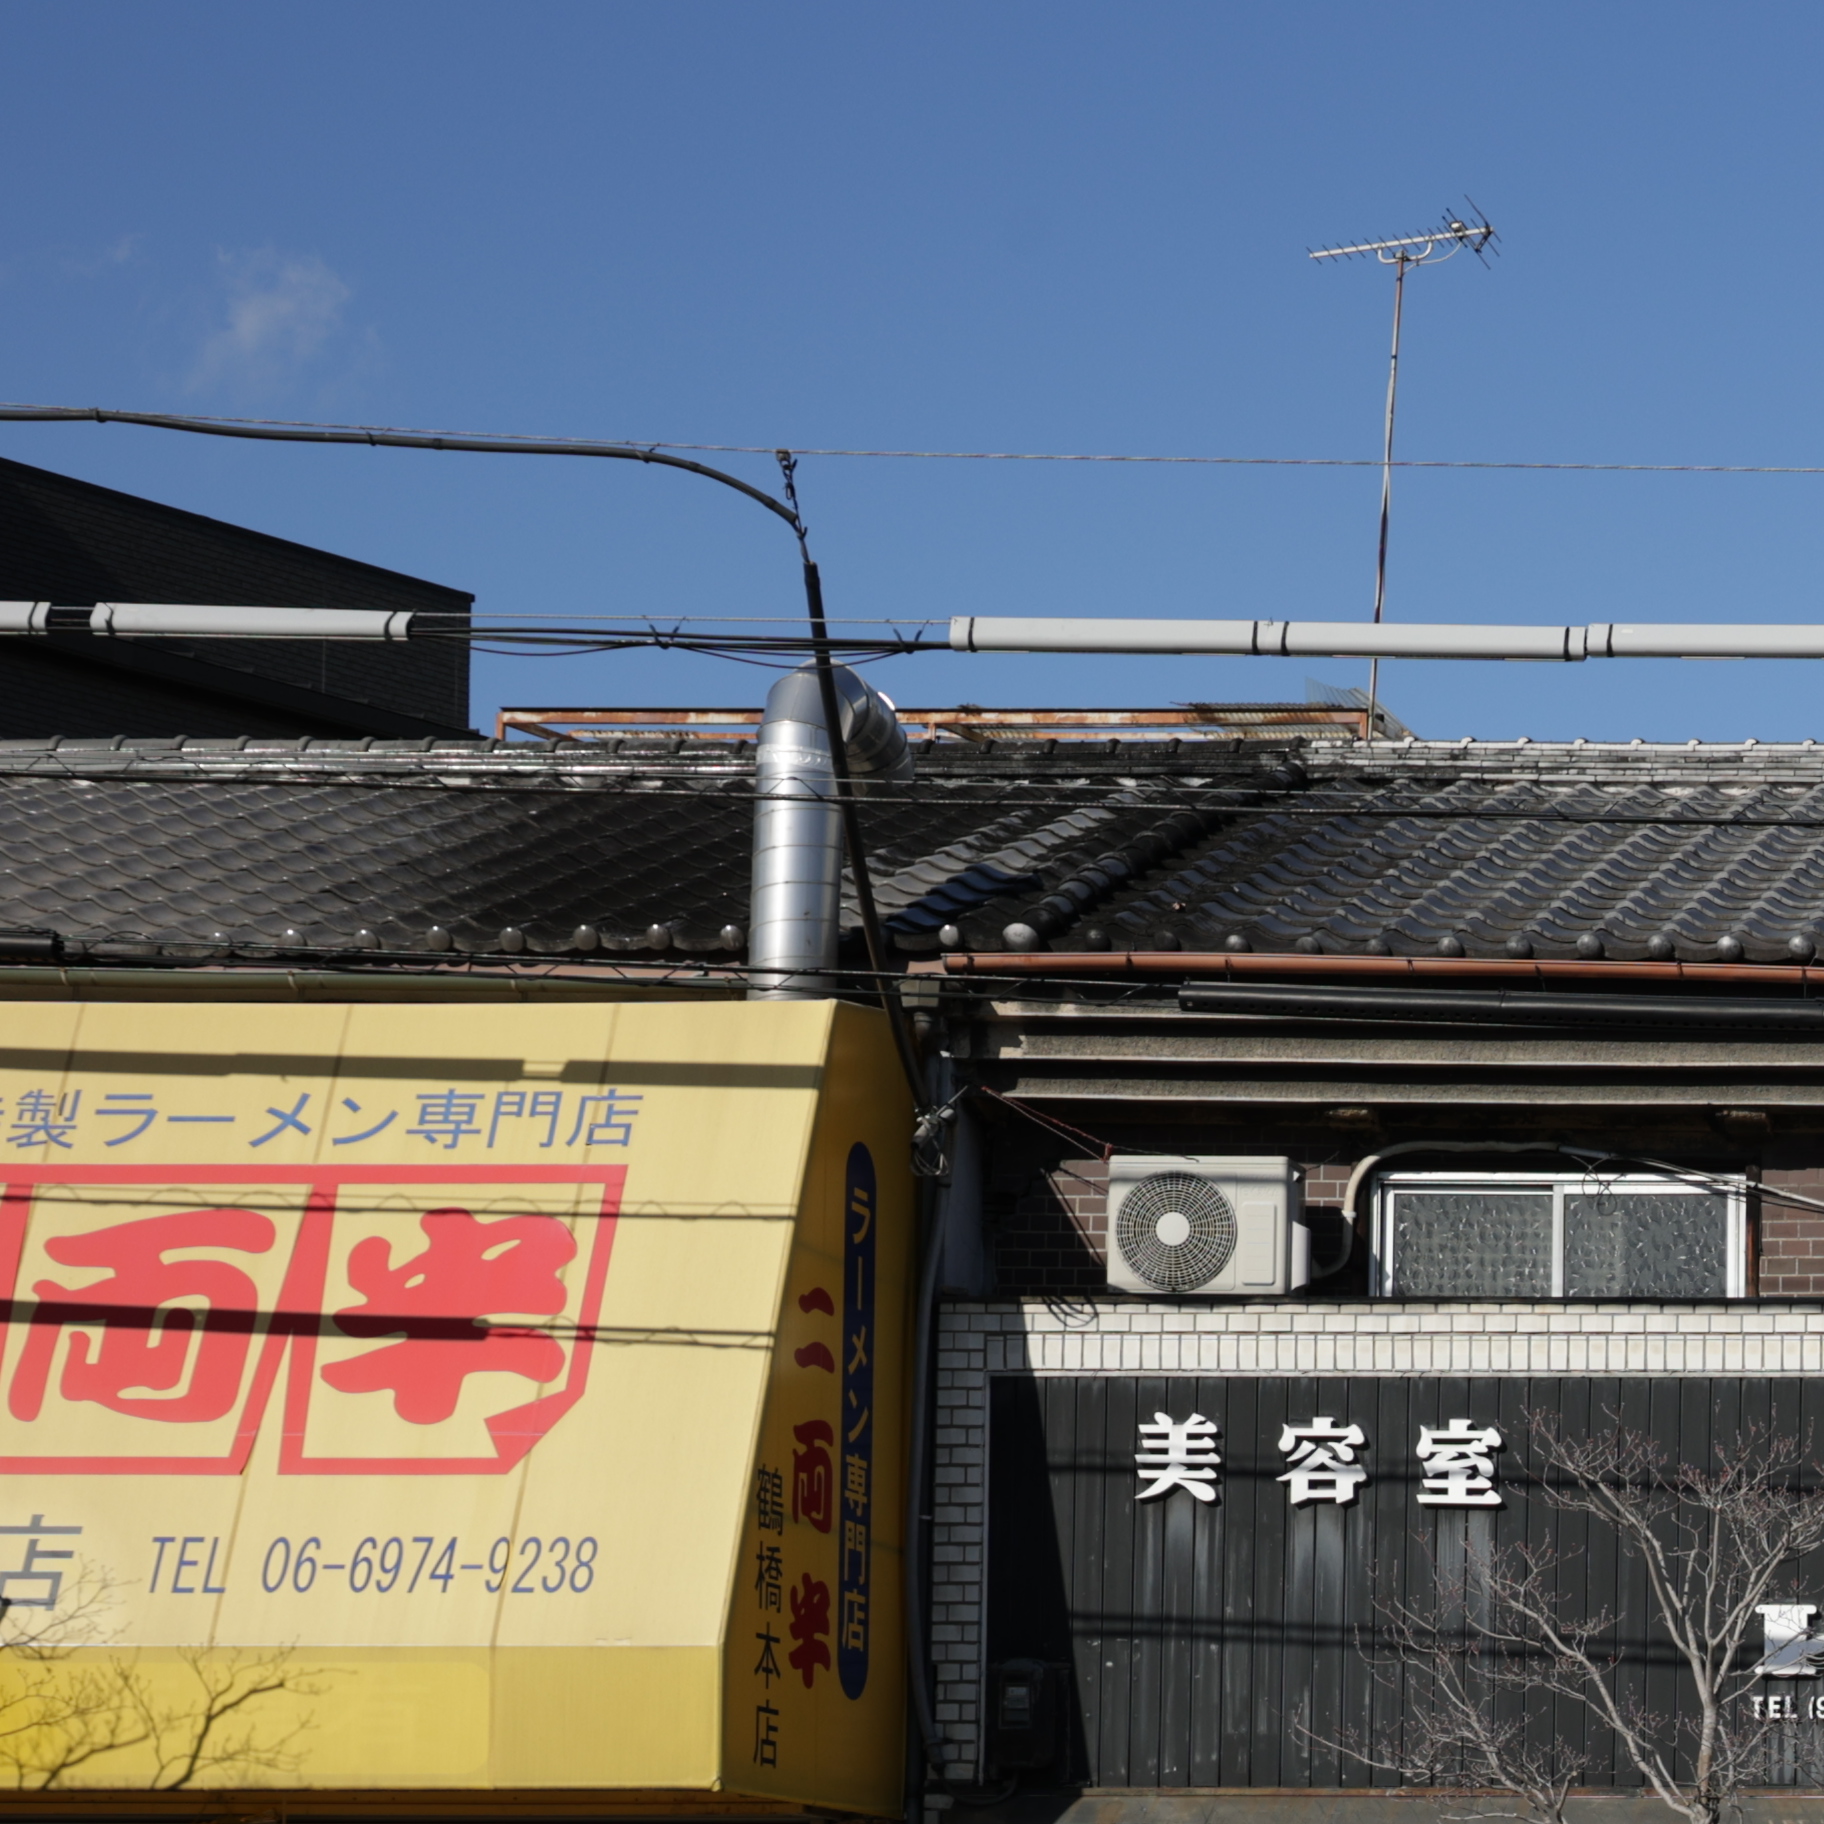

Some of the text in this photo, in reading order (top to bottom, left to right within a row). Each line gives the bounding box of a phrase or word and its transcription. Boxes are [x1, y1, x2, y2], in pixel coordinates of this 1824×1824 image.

[0, 1088, 644, 1150] 製ラーメン専門店
[840, 1186, 873, 1653] ラーメン専門店
[1133, 1411, 1503, 1508] 美容室
[148, 1537, 599, 1596] TEL 06-6974-9238
[753, 1462, 785, 1770] 鶴橋本店
[1752, 1696, 1798, 1722] TEL
